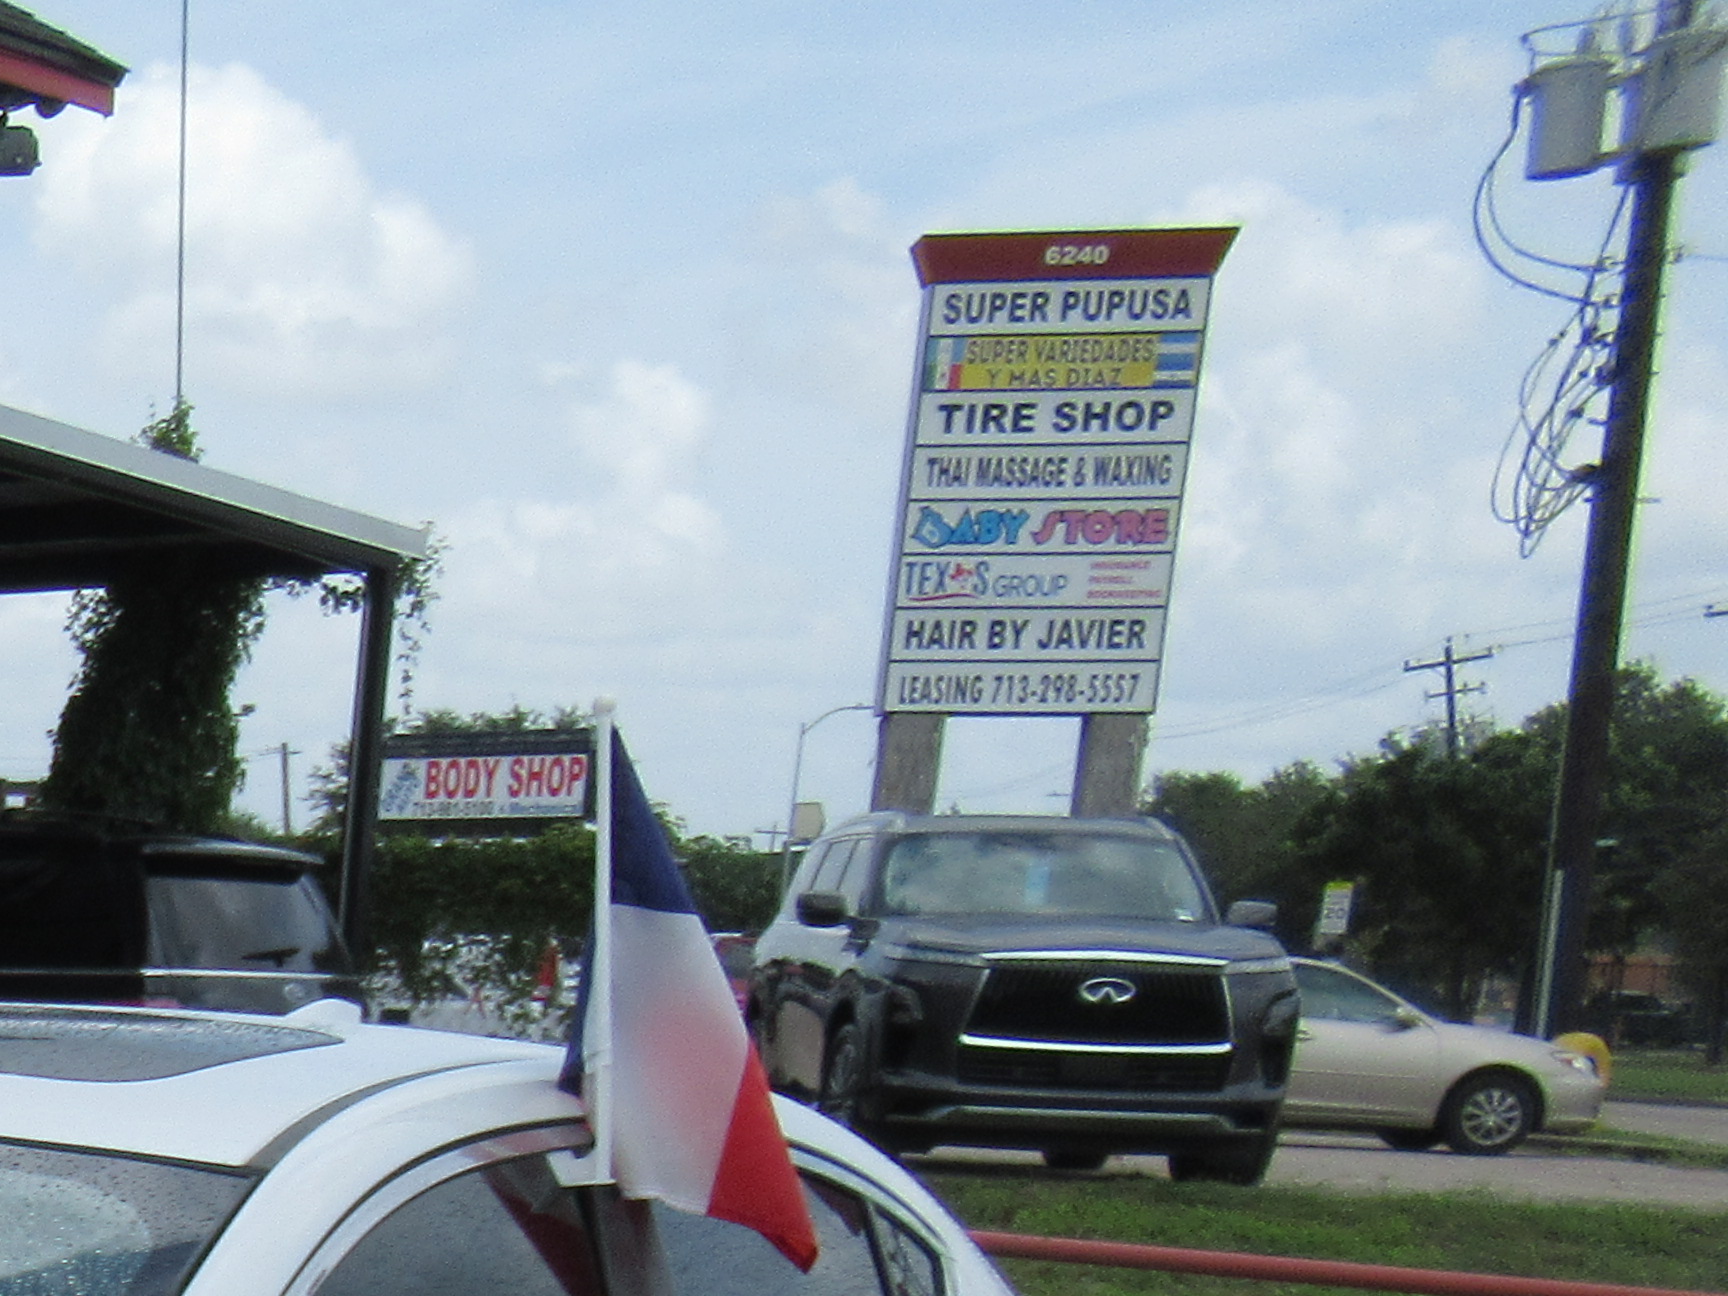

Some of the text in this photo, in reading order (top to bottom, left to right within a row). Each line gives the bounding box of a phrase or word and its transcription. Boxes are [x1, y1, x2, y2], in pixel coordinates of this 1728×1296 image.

[1045, 245, 1110, 265] 6240
[944, 288, 1193, 325] SUPER PUPUSA
[965, 337, 1157, 365] SUPER VARIEDADES
[986, 366, 1123, 387] Y MAS DIAZ
[938, 400, 1175, 434] TIRE SHOP
[927, 453, 1173, 488] THAI MASSAGE & WAXING
[911, 505, 1171, 549] BABY STORE
[994, 574, 1068, 598] GROUP
[905, 618, 1147, 650] HAIR BY JAVIER
[899, 673, 1141, 705] LEASING 713-298-5557
[424, 756, 588, 800] BODY SHOP
